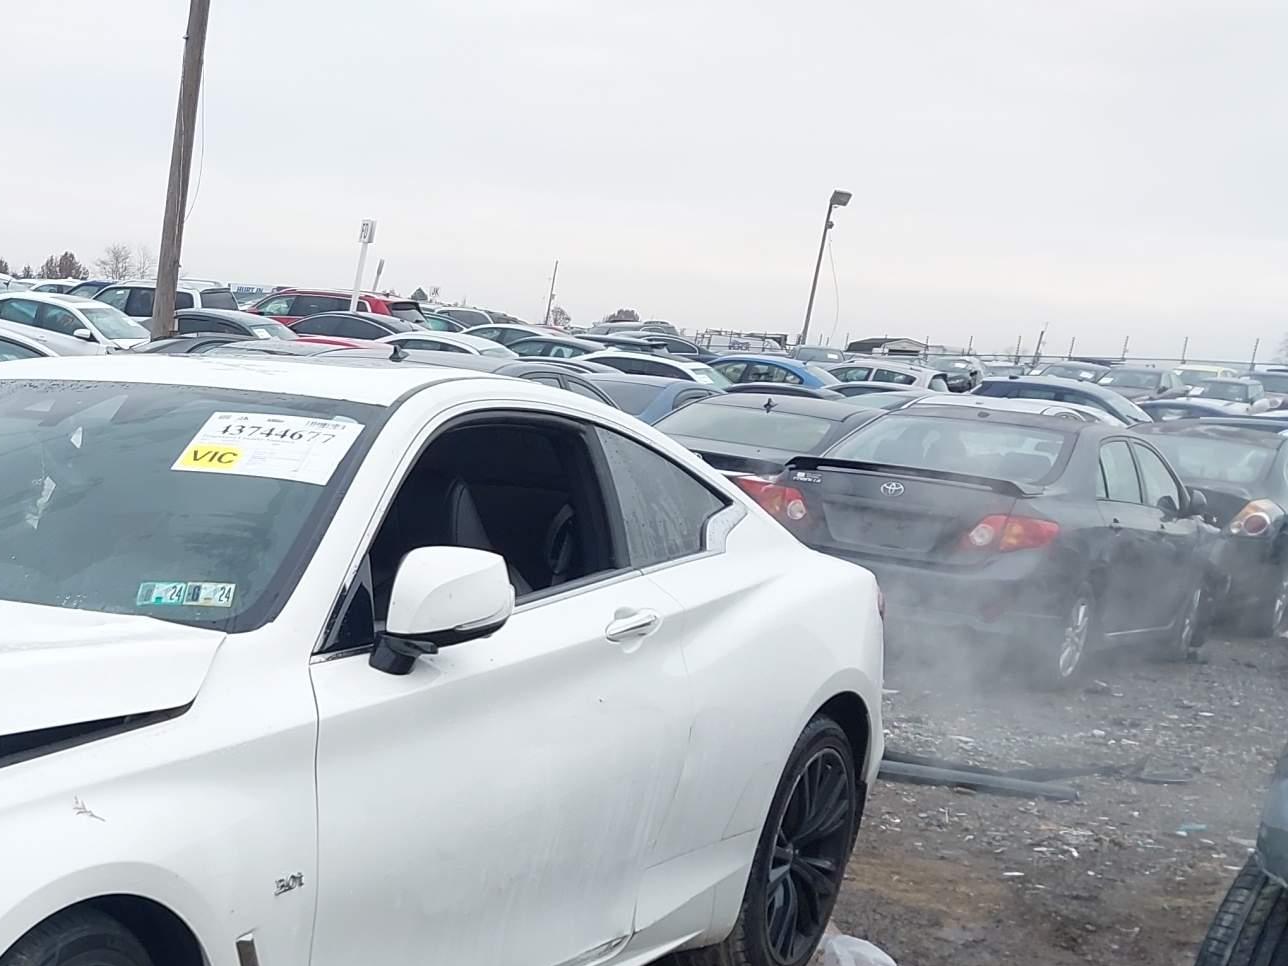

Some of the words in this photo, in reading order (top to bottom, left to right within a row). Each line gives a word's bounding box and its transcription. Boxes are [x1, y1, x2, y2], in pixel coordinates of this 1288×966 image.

[192, 449, 238, 464] VIC
[169, 585, 183, 601] 24
[218, 586, 231, 603] 24
